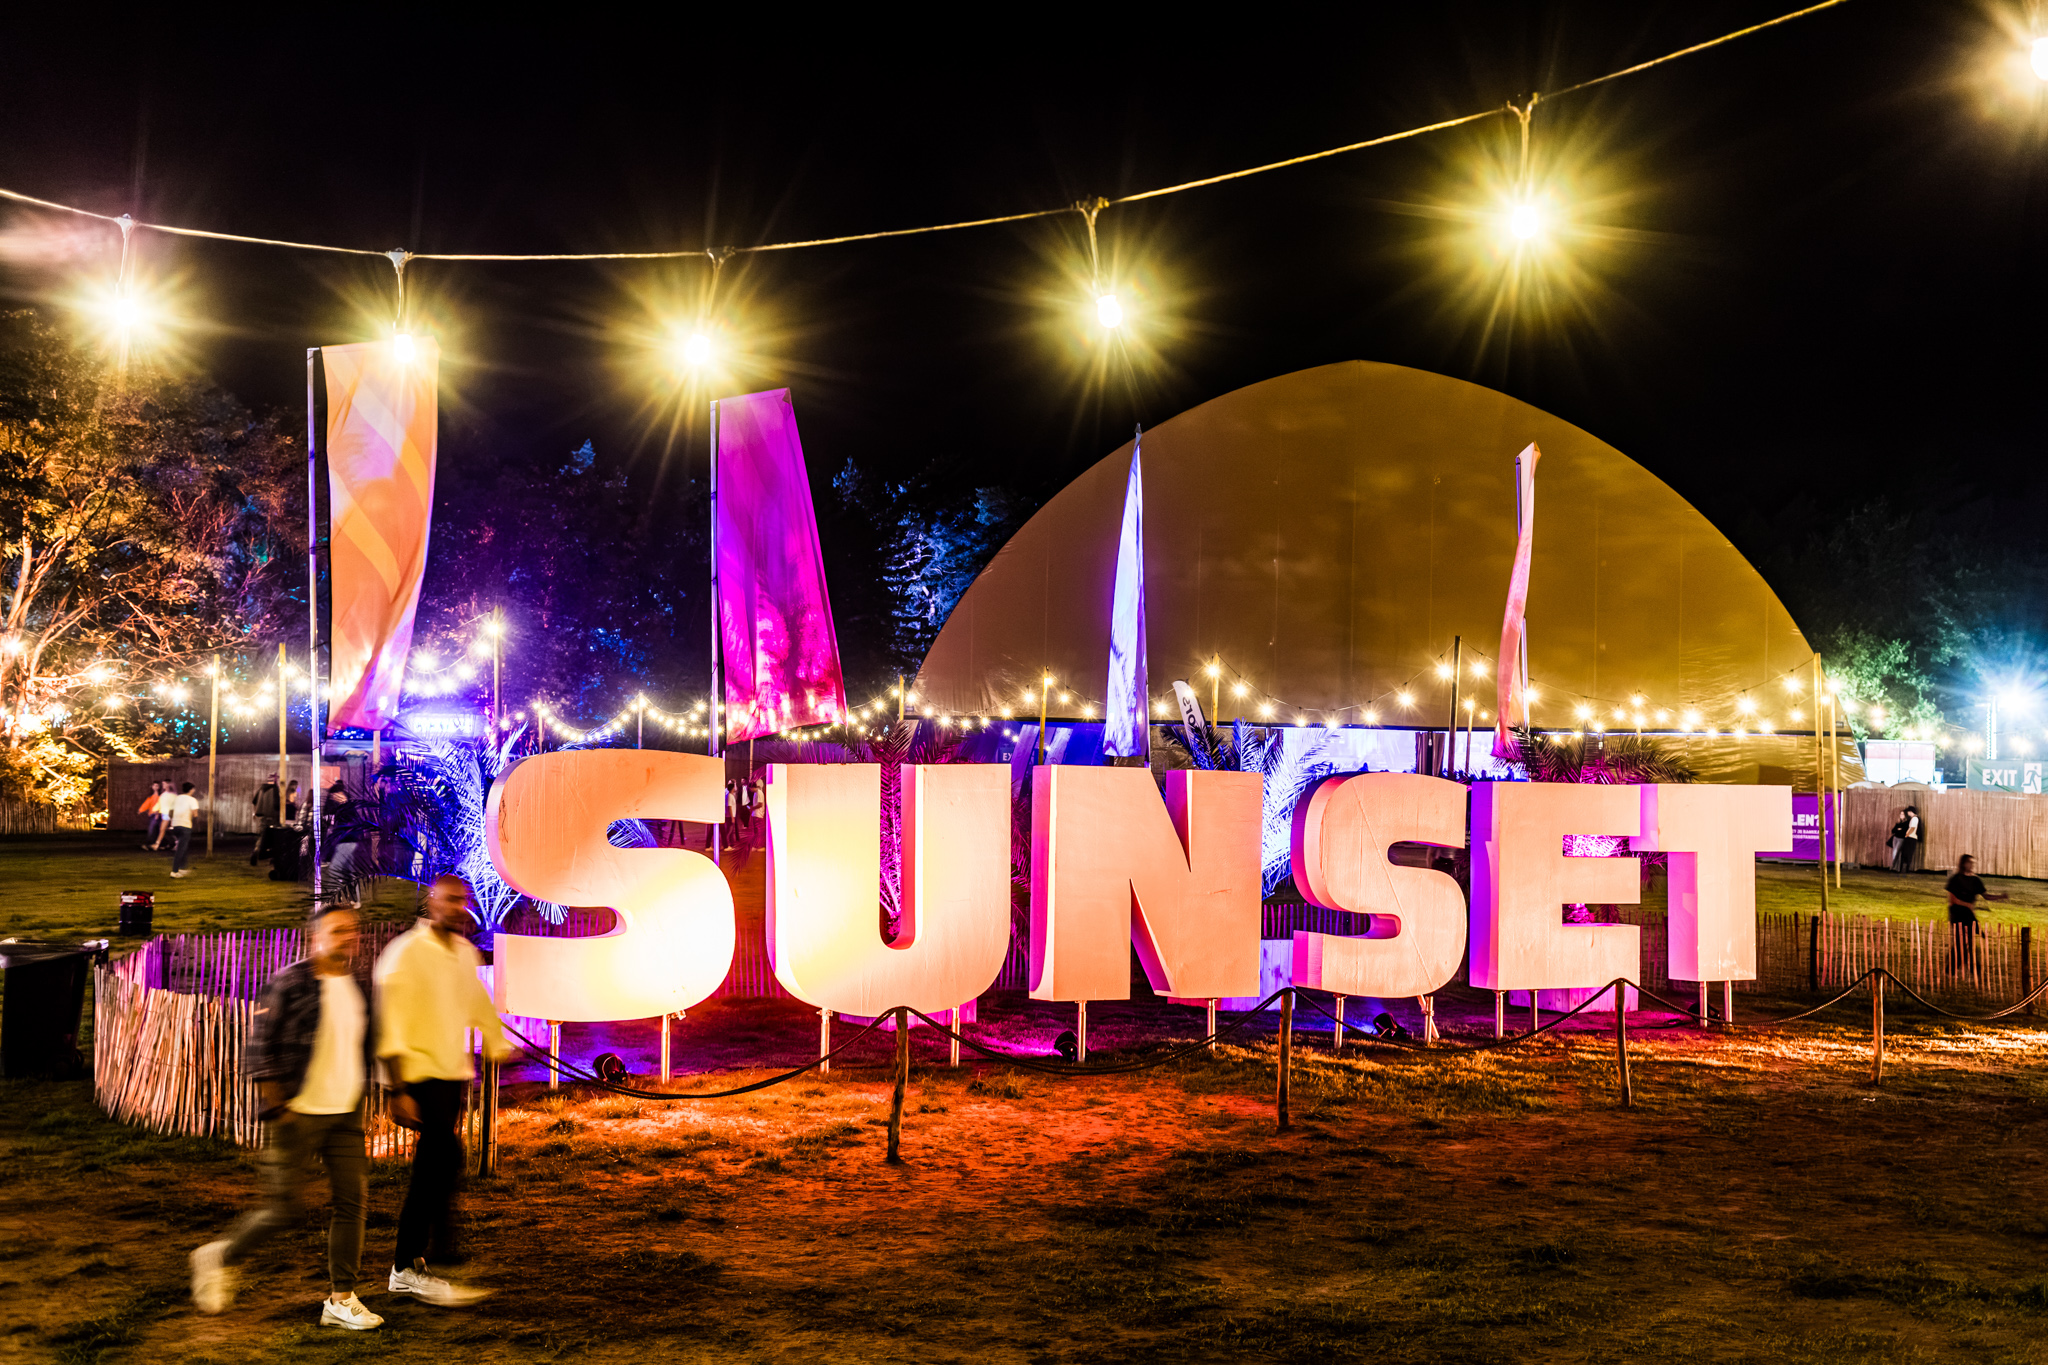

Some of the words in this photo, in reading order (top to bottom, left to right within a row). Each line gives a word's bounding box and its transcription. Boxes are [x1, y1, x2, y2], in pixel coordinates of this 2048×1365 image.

[1982, 769, 2018, 787] EXIT
[1792, 813, 1820, 827] LEN?
[483, 747, 1793, 1022] SUNSET
